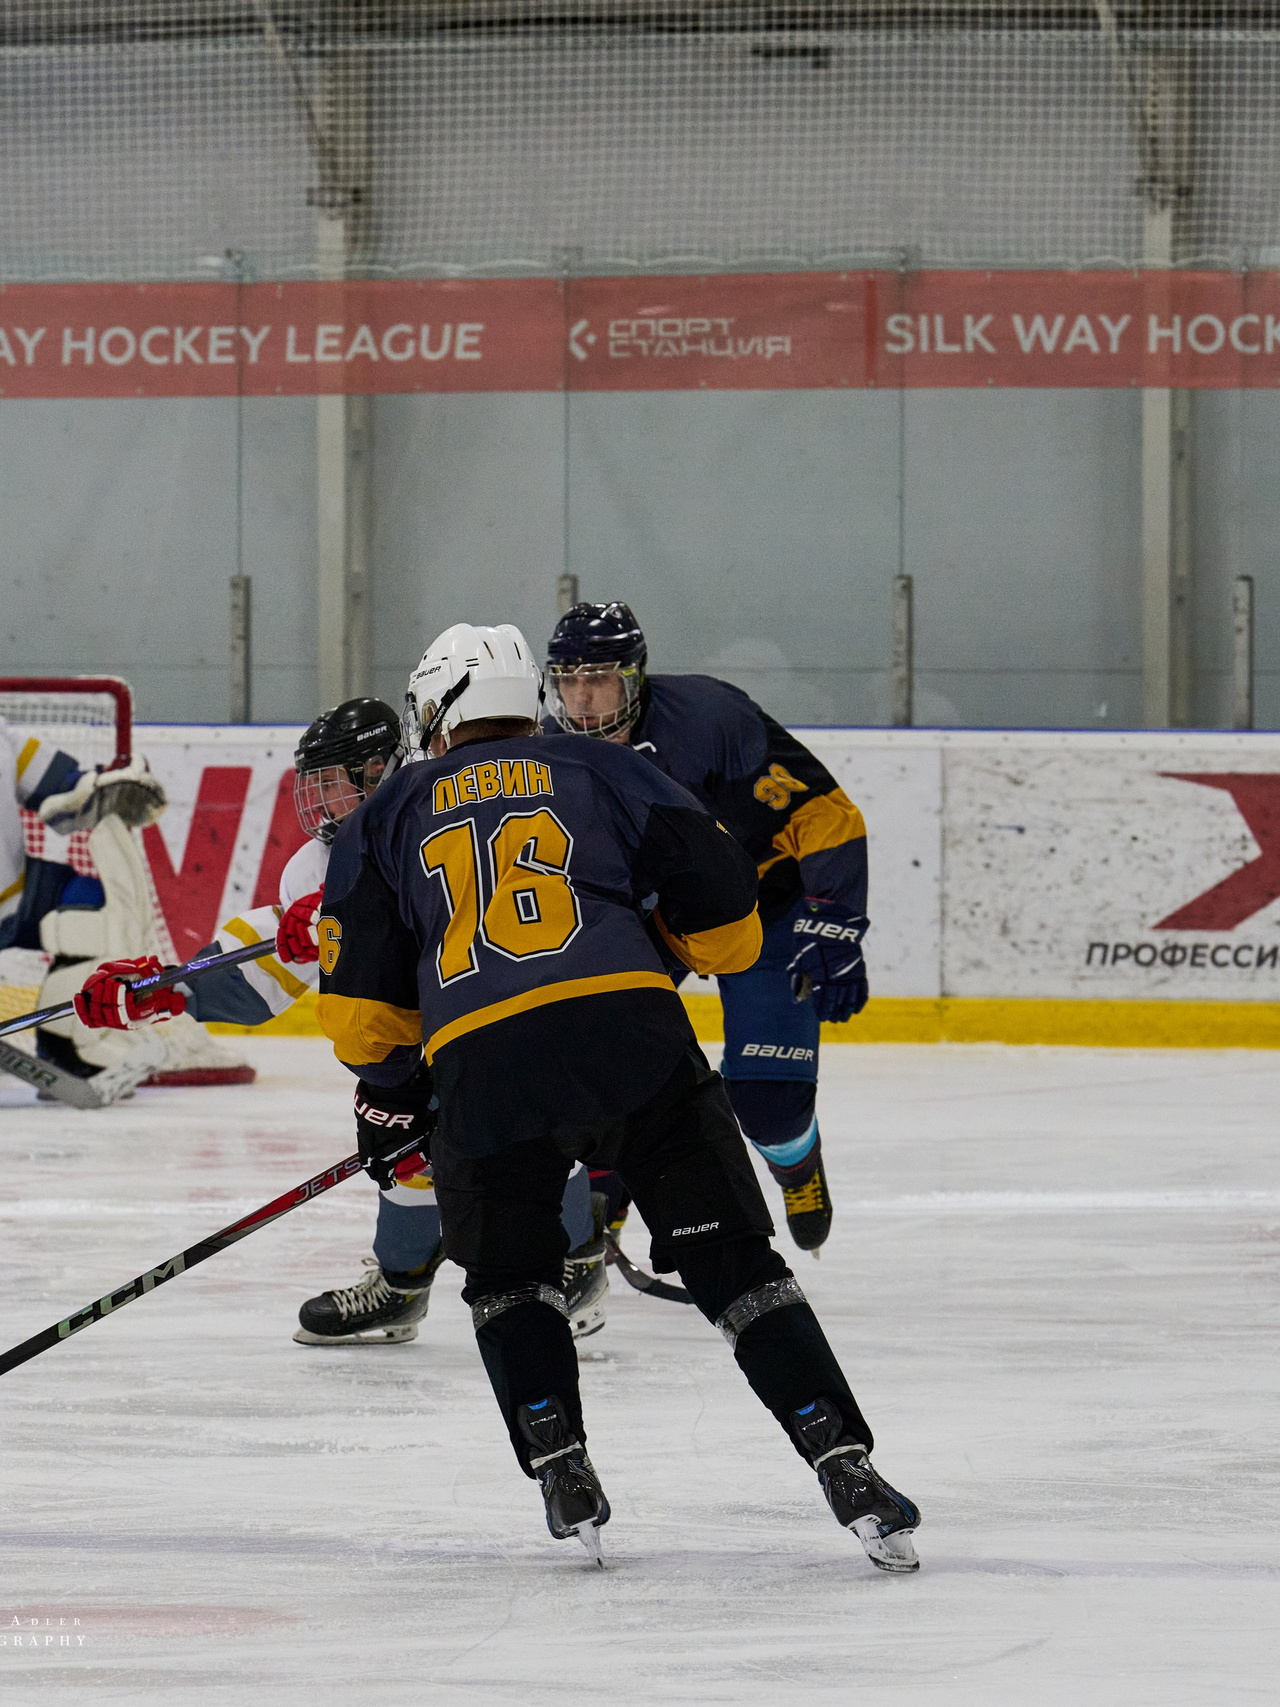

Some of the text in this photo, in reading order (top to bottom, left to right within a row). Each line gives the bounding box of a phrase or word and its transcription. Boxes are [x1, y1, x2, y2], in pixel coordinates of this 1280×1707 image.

[62, 326, 271, 366] HOCKEY
[285, 323, 484, 363] LEAGUE
[609, 318, 735, 338] СПОРТ
[885, 314, 997, 354] SILK
[1012, 314, 1131, 354] WAY
[609, 336, 791, 359] СТАНЦИЯ
[433, 759, 554, 815] ЛЕВИН
[419, 807, 584, 989] 16
[793, 918, 860, 943] AUER
[1086, 941, 1280, 970] ПРОФЕССИ
[354, 1094, 415, 1130] UER
[57, 1251, 187, 1339] CCM
